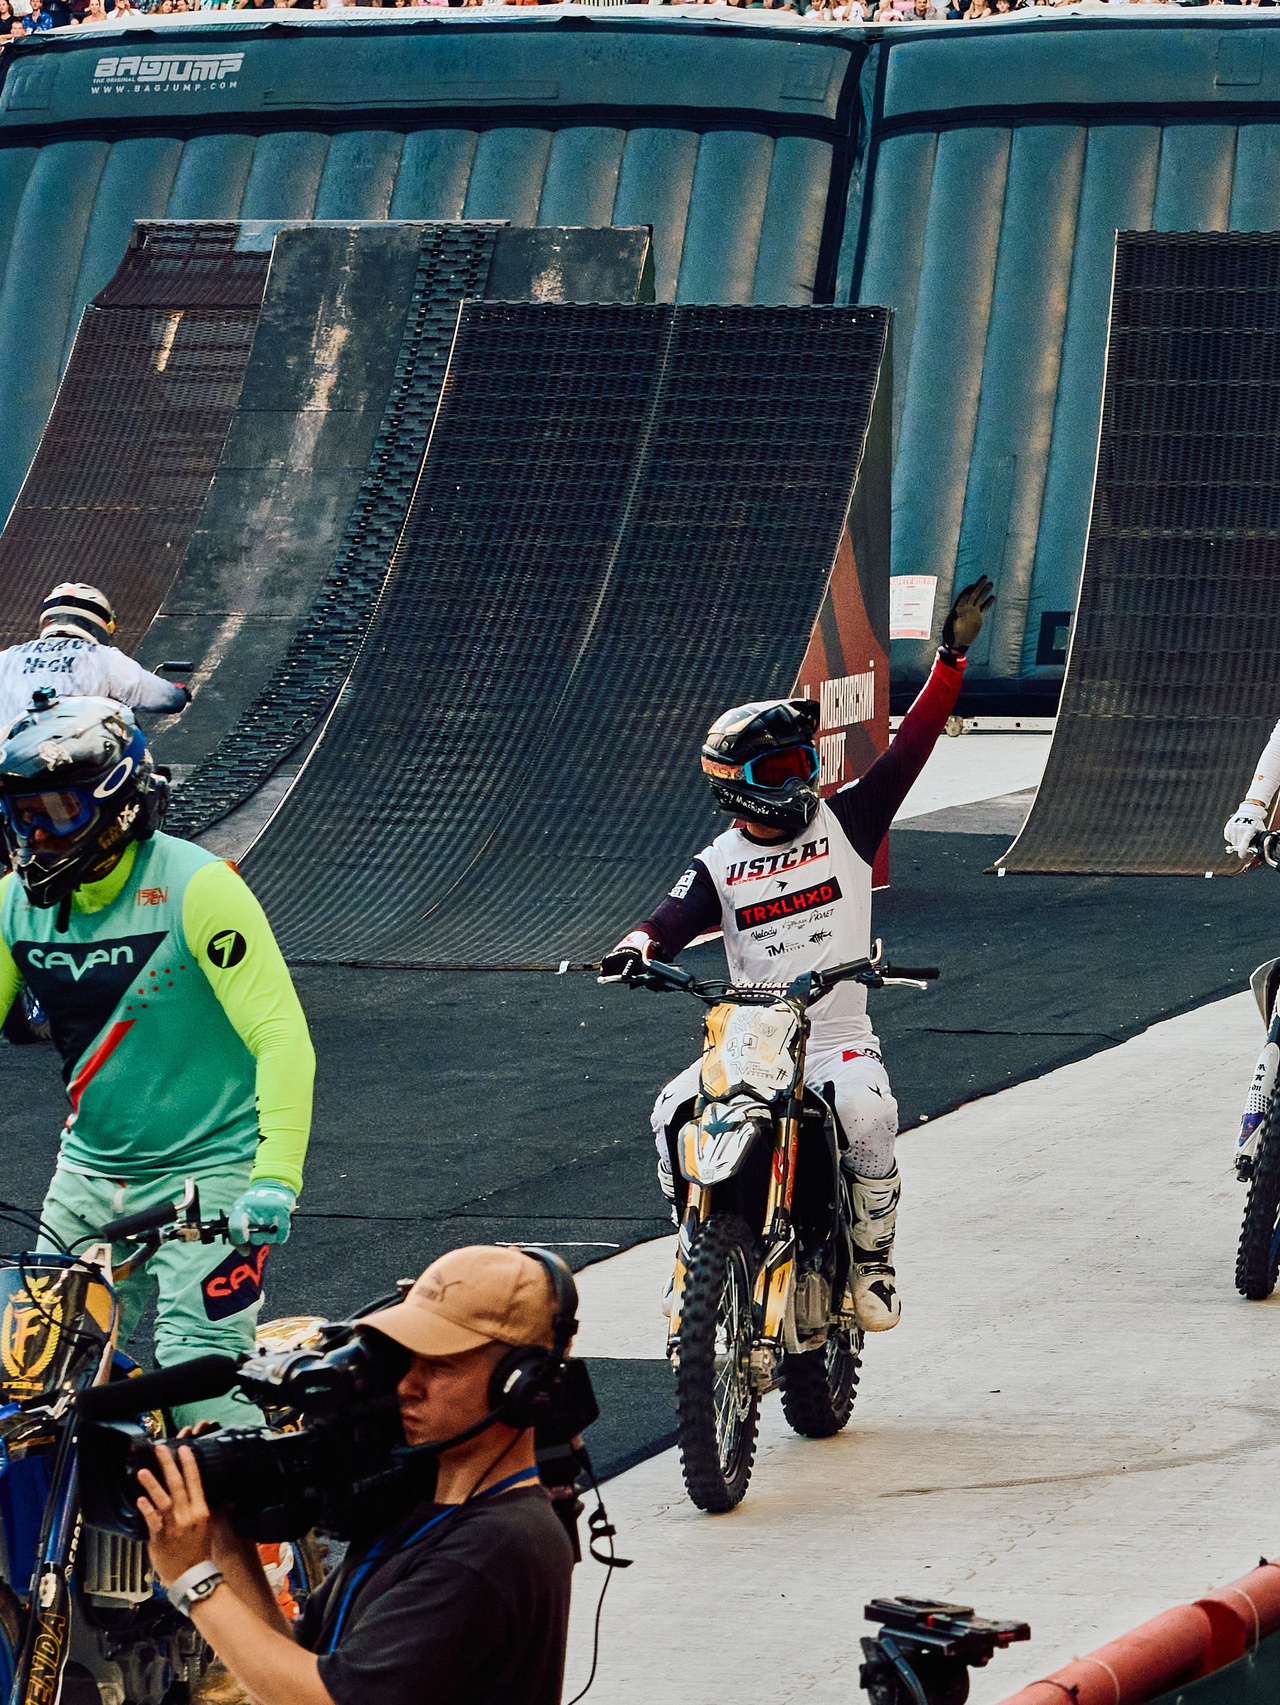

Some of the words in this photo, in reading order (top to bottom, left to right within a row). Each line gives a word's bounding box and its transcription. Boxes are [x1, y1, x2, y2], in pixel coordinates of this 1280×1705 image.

[95, 53, 245, 82] BAGJUMP
[91, 81, 238, 94] WWW.BAGJUMP.COM
[741, 885, 834, 925] TRXLHXD
